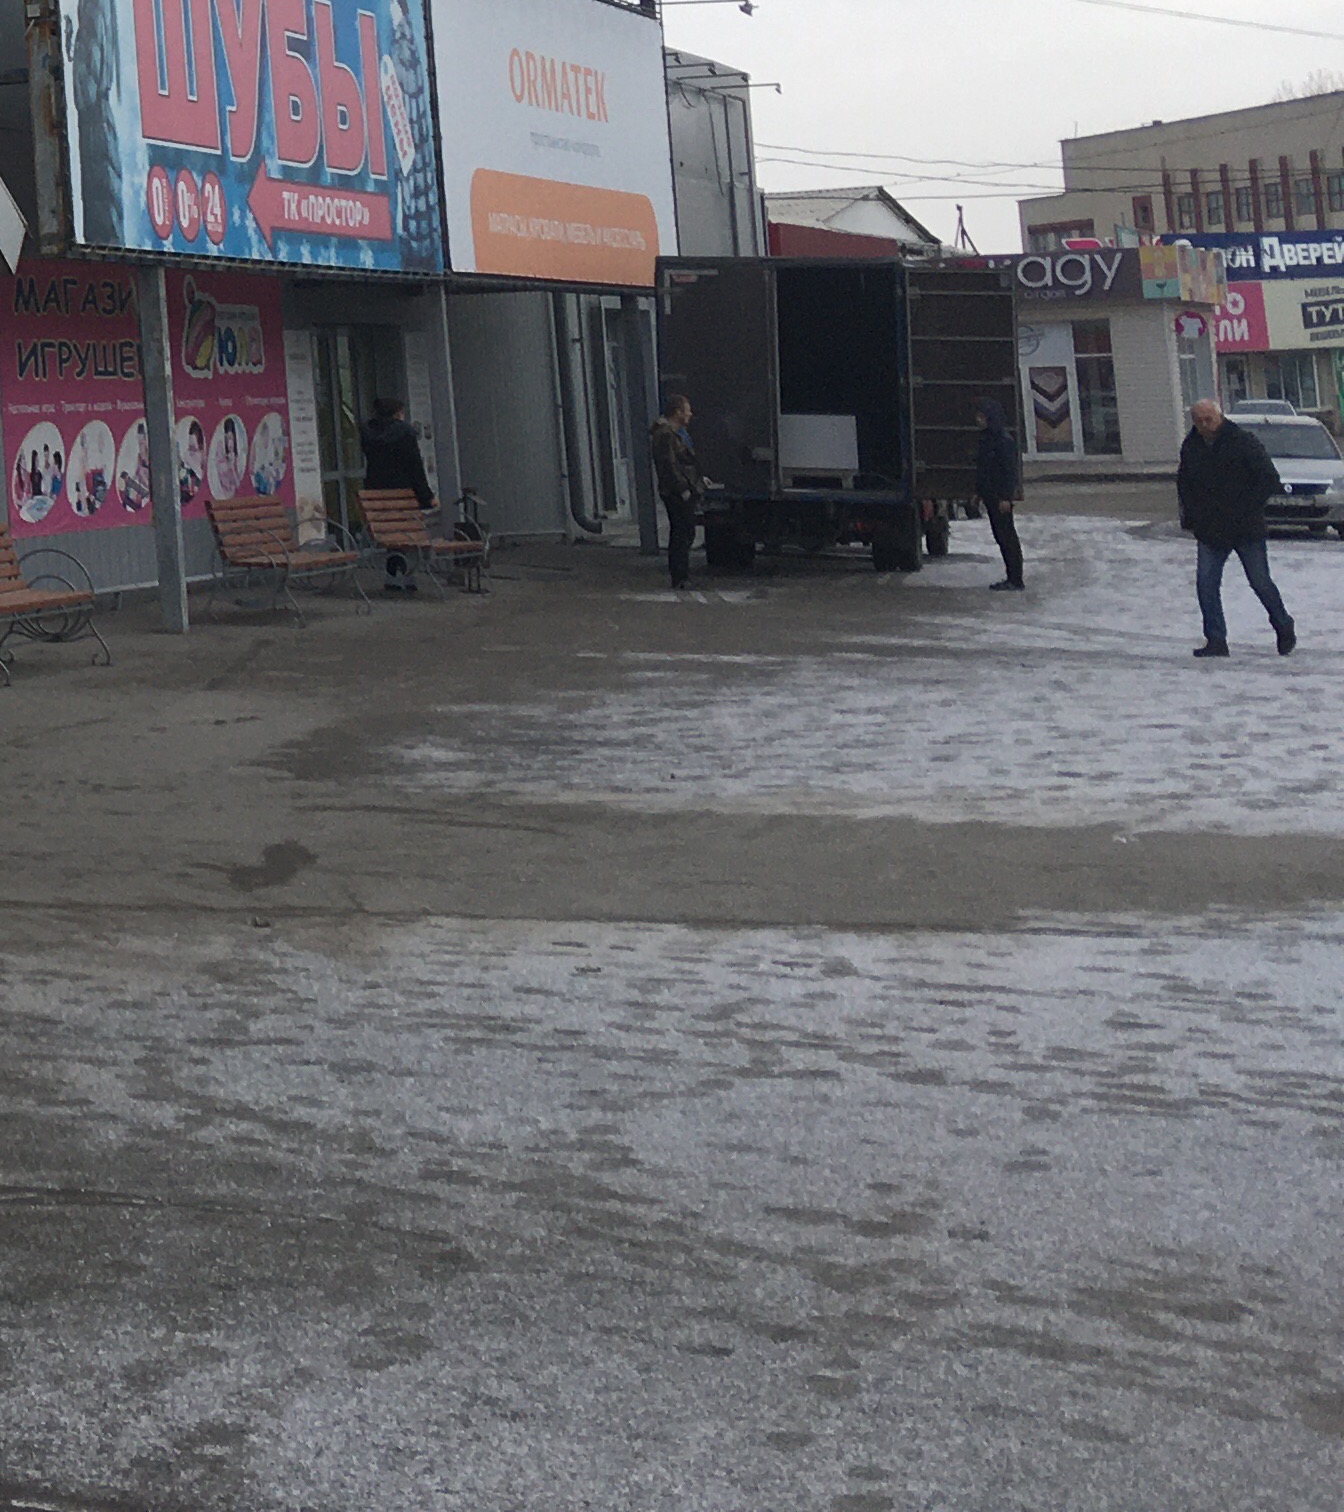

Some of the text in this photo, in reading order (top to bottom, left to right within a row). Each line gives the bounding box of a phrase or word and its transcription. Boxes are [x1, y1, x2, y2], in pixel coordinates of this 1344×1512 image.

[509, 48, 608, 122] ORMATEK
[282, 191, 370, 227] ТК «ПРОСТОР»
[14, 275, 136, 317] МАГАЗИ
[16, 338, 140, 380] ИГРУШЕ
